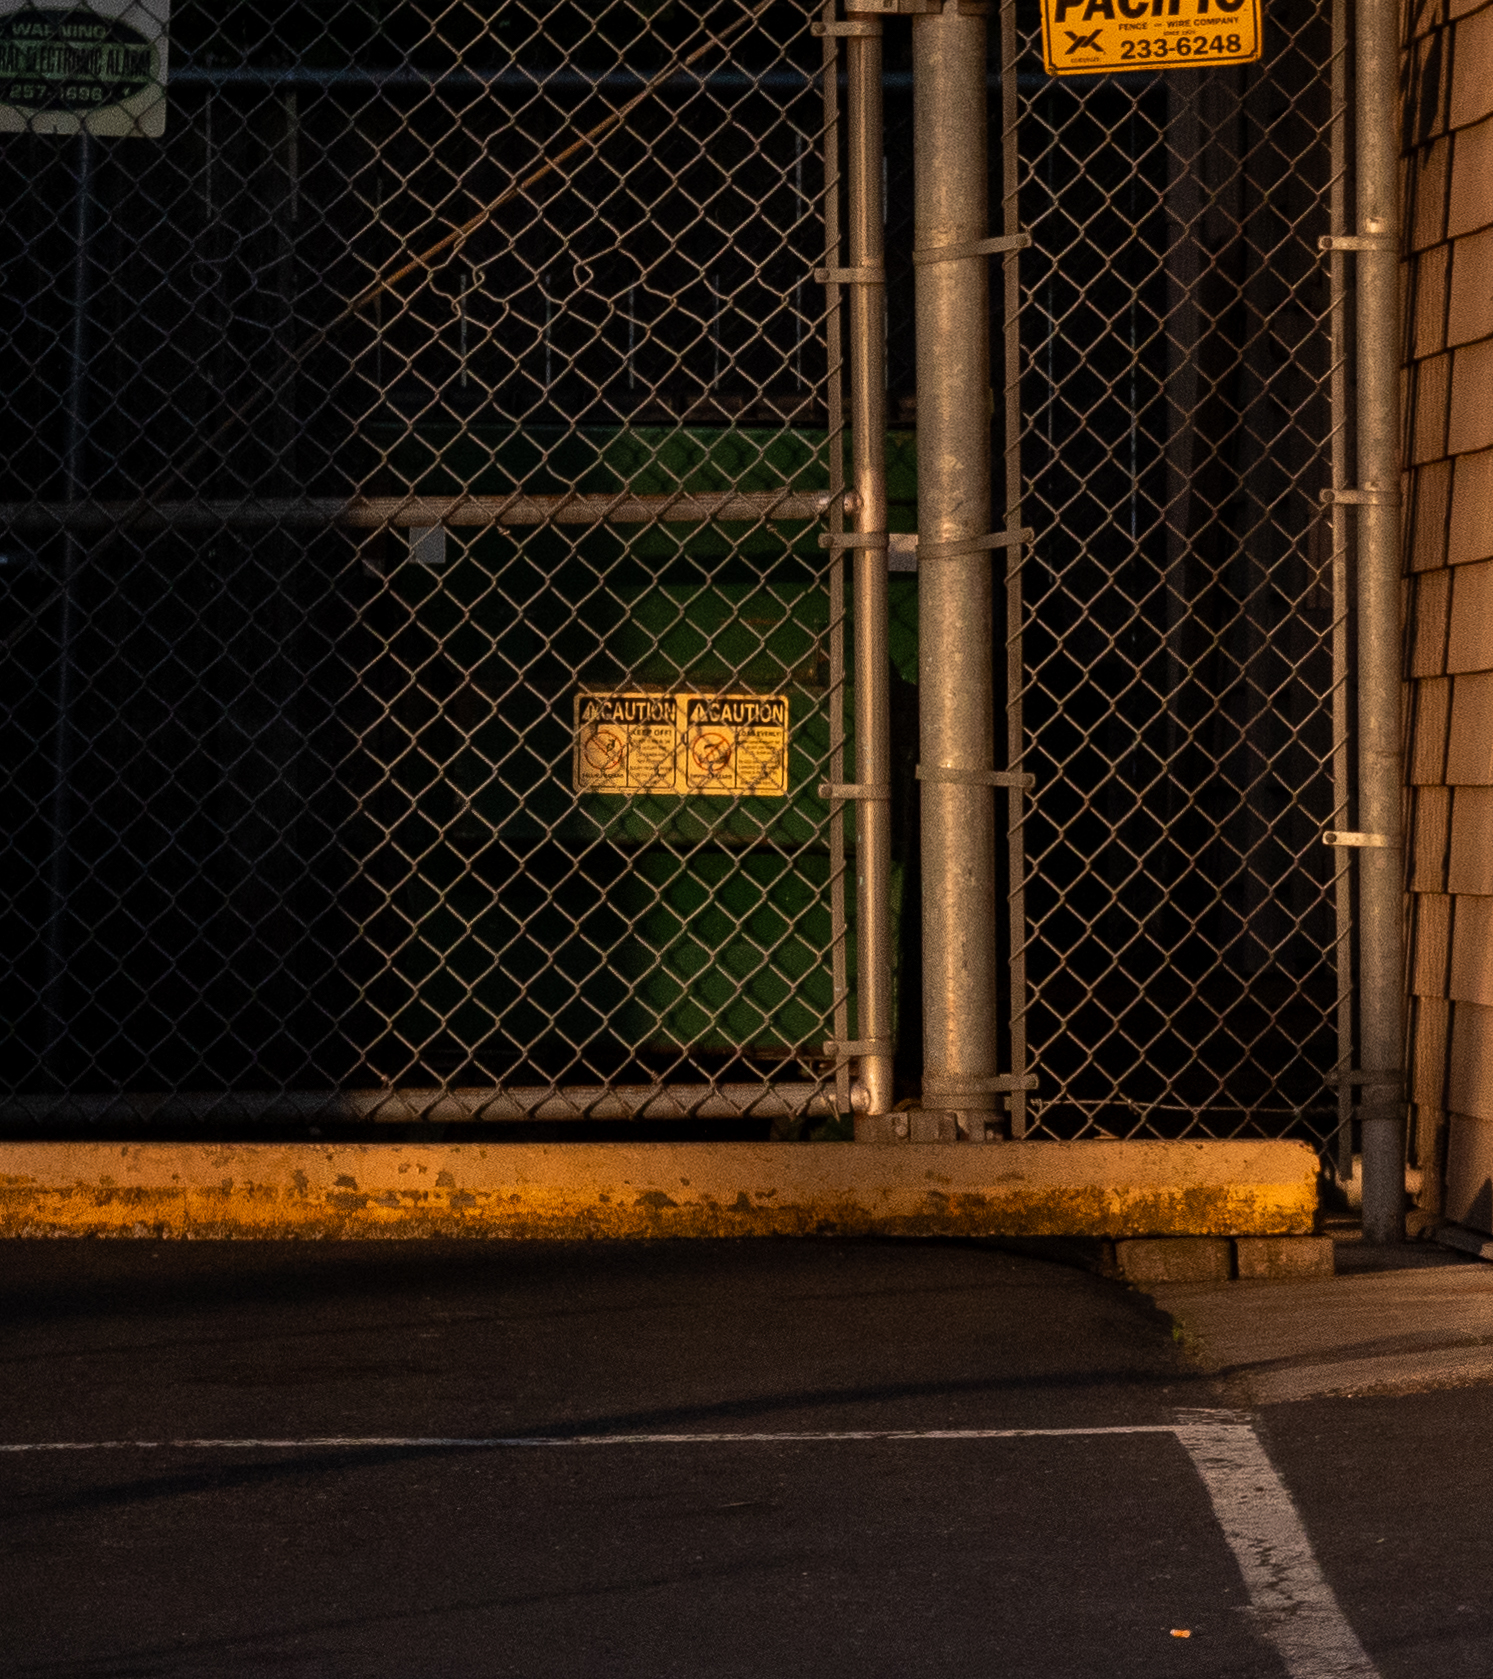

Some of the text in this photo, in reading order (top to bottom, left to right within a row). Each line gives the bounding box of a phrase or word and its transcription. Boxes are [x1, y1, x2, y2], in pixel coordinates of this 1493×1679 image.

[1118, 22, 1148, 32] FENCE
[1166, 19, 1191, 29] WIRE
[1193, 17, 1239, 28] COMPANY
[1120, 34, 1242, 60] 233-6248
[601, 701, 676, 721] CAUTION
[708, 703, 784, 723] CAUTION
